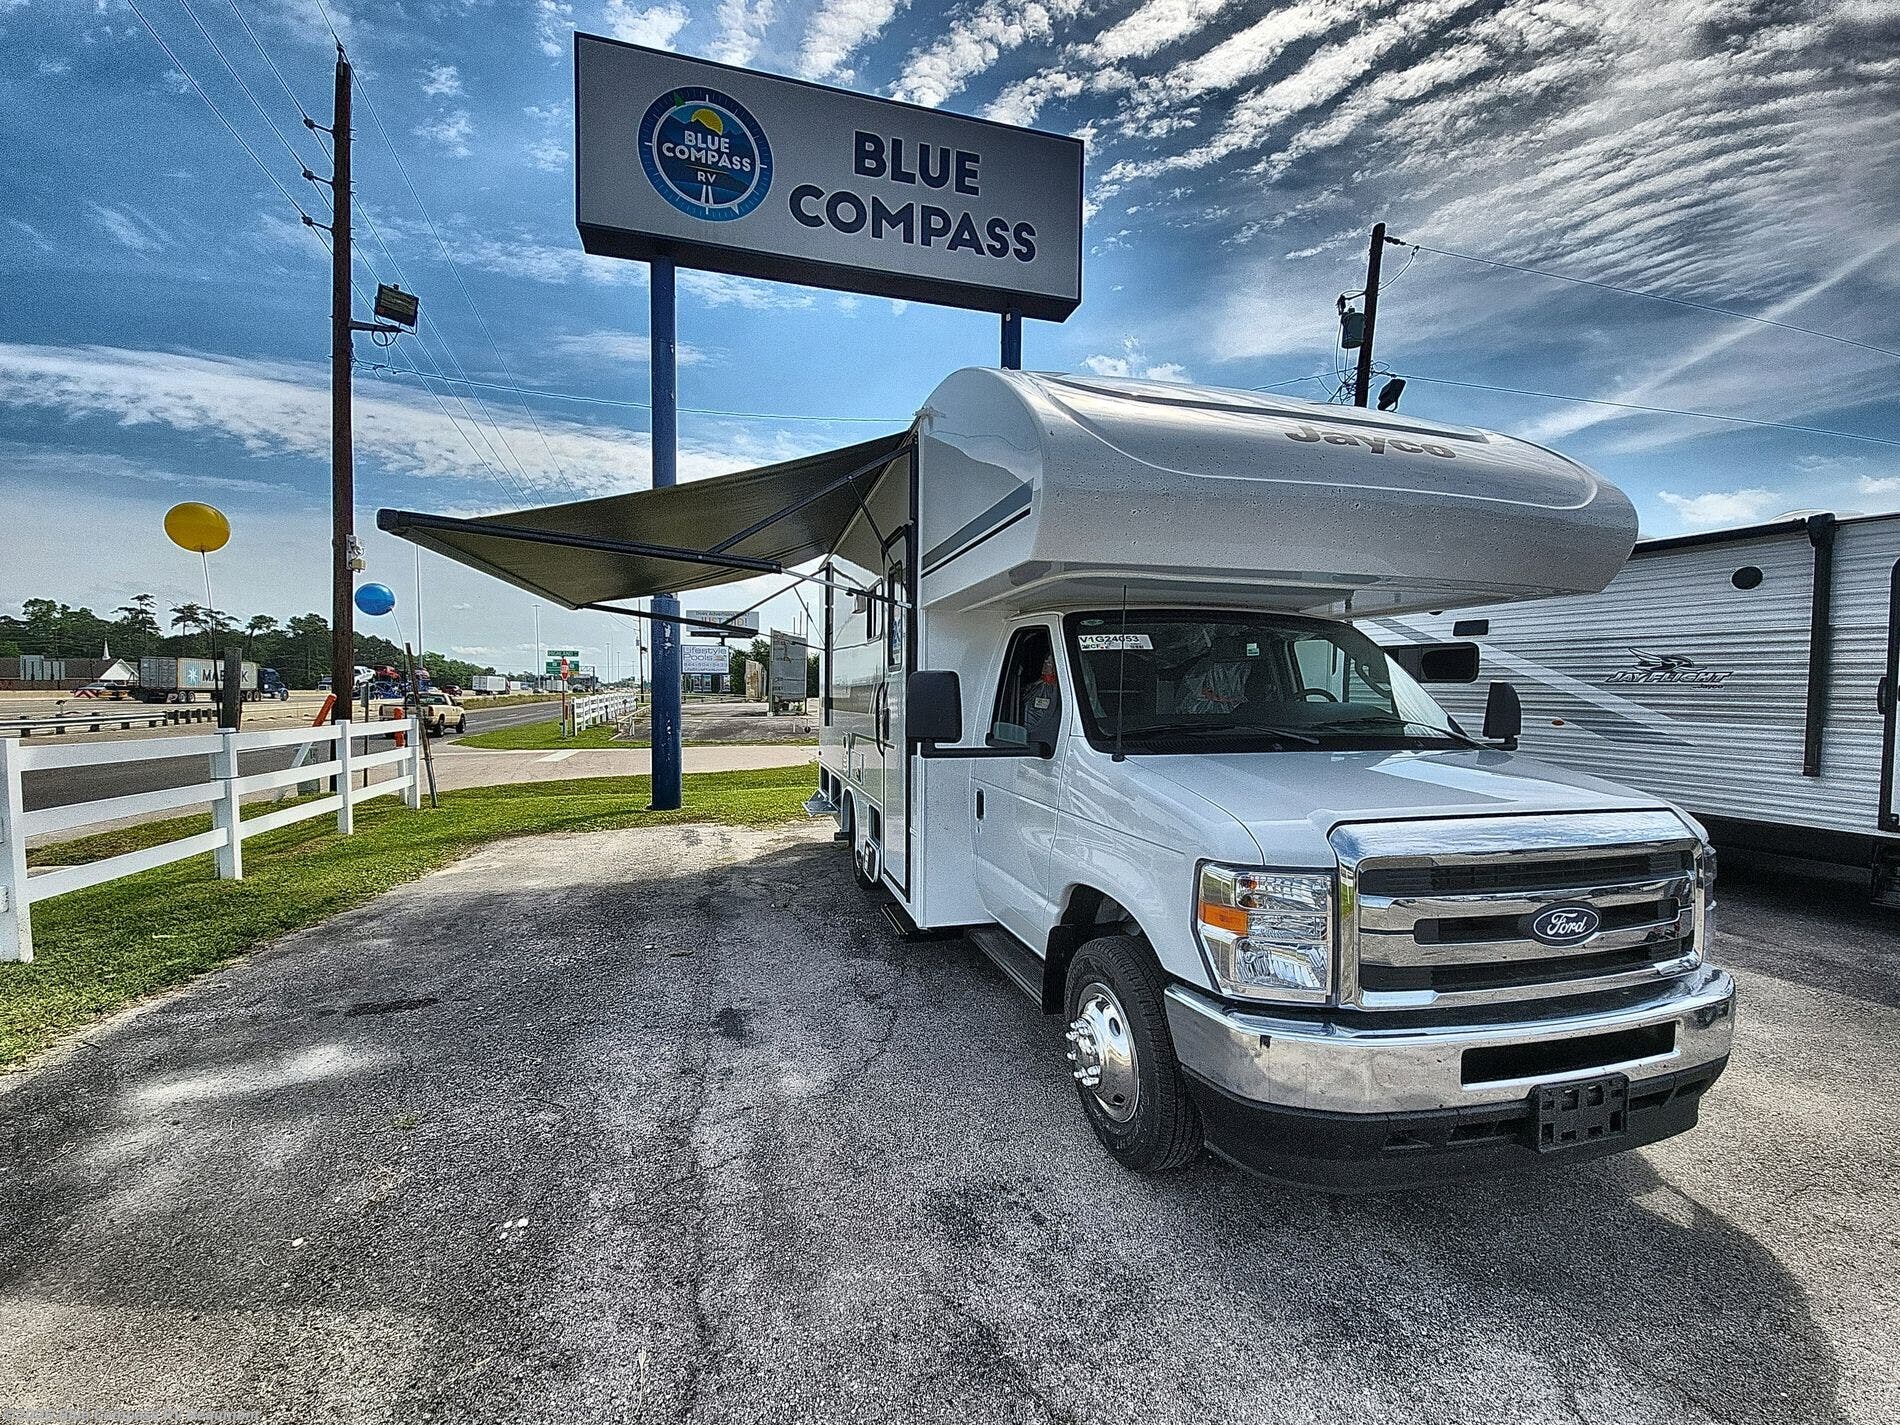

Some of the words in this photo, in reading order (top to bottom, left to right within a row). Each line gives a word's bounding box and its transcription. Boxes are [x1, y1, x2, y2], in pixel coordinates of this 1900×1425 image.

[684, 130, 730, 153] BLUE
[662, 142, 752, 172] COMPASS
[853, 130, 981, 197] BLUE
[697, 171, 717, 184] RV
[788, 184, 1037, 263] COMPASS
[1284, 425, 1457, 459] Jayco
[683, 646, 727, 655] Lifestyle
[202, 669, 249, 682] MAEK
[1546, 912, 1588, 935] Ford
